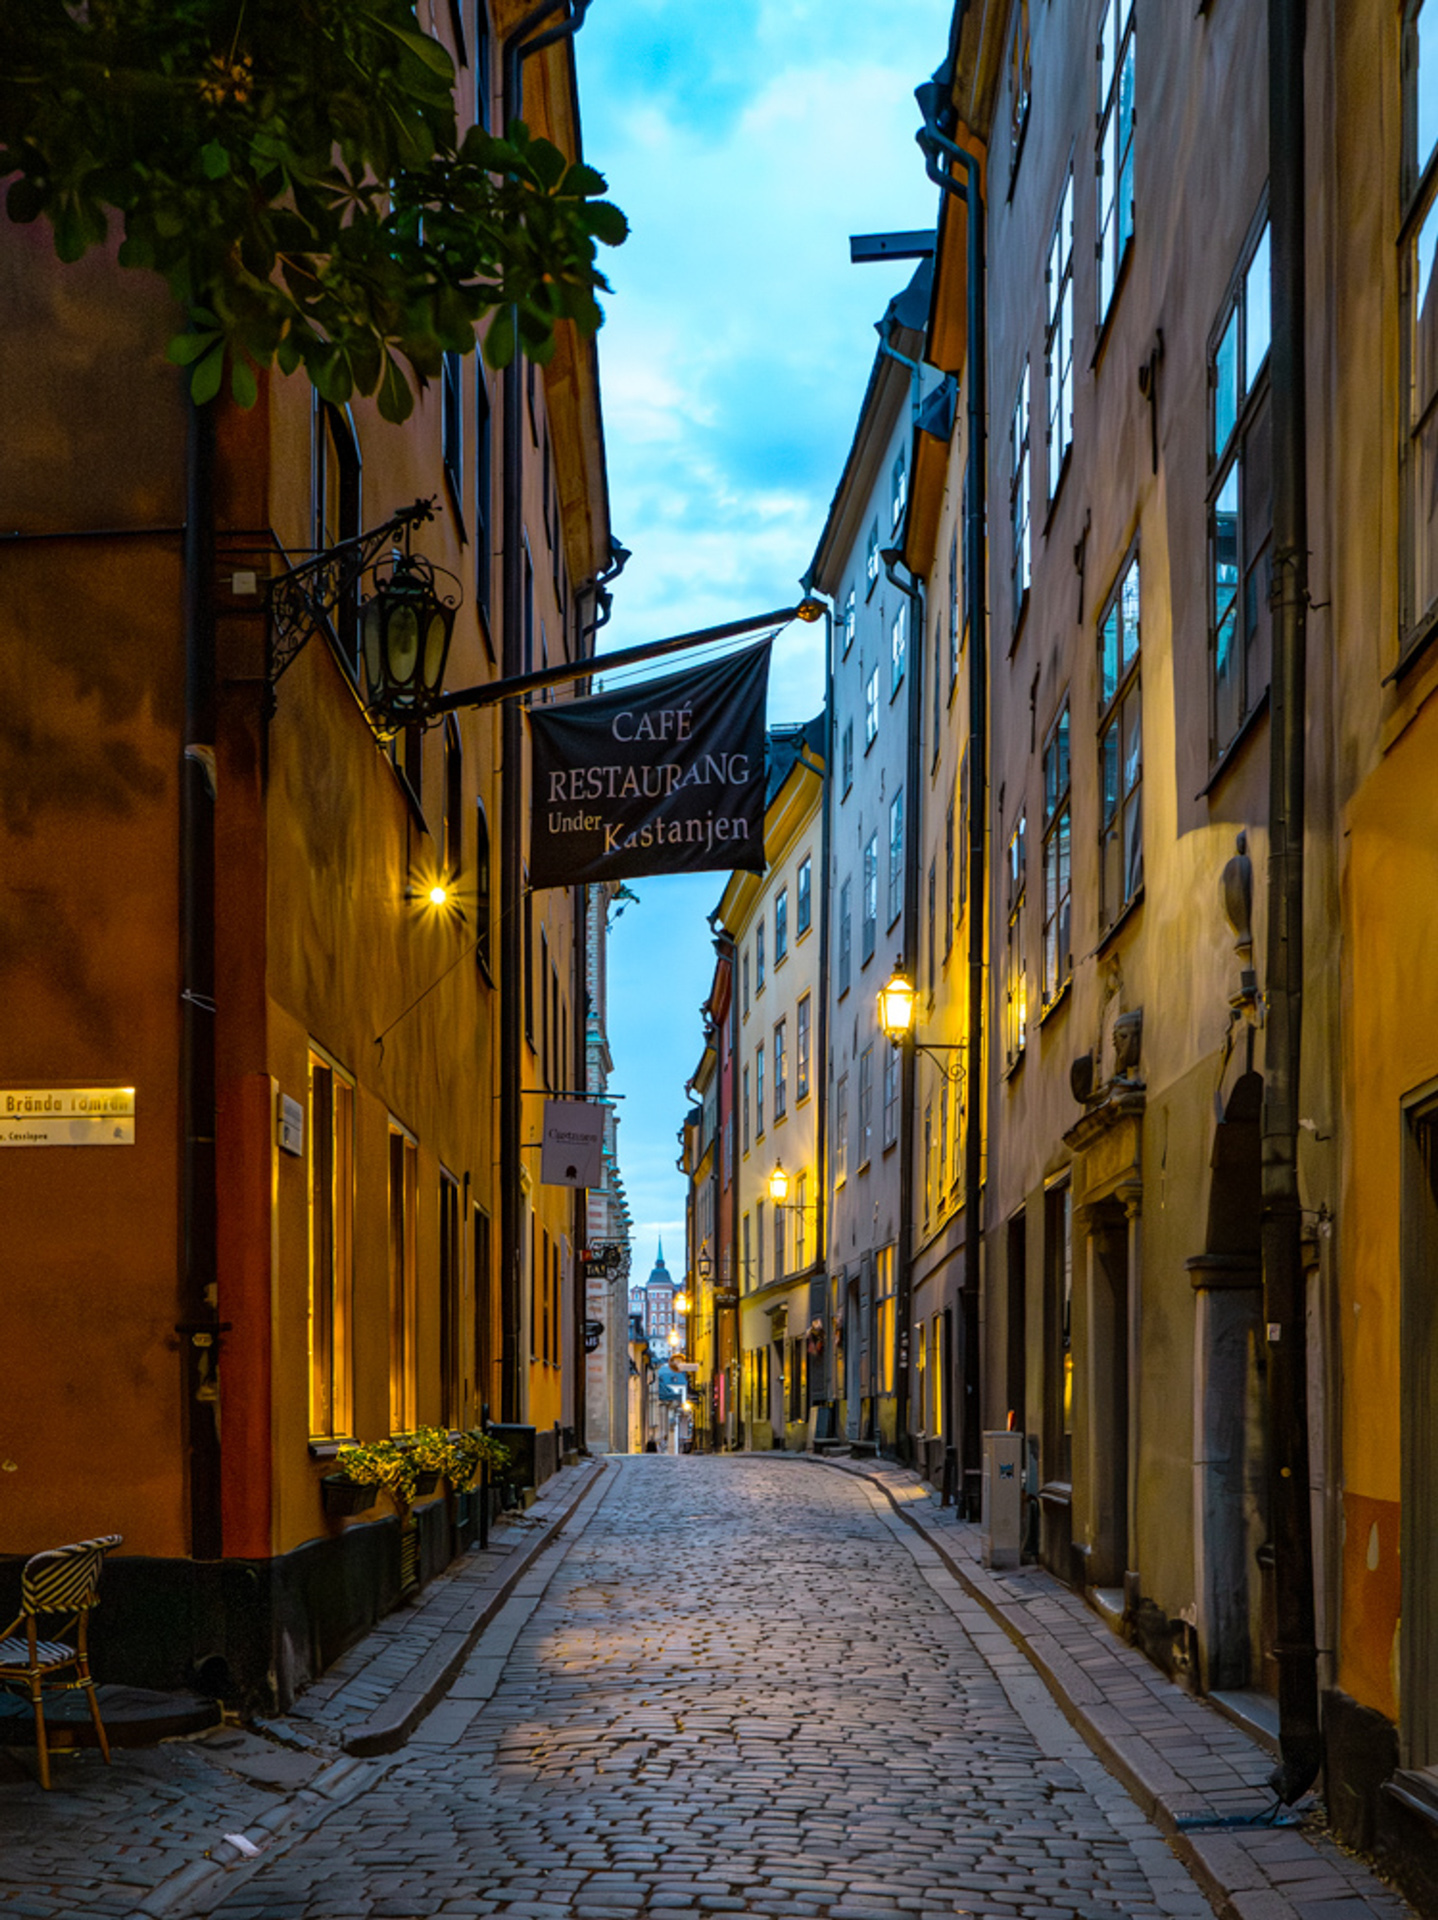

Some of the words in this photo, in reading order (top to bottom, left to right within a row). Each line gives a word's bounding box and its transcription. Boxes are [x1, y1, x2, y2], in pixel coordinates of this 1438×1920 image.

[611, 701, 693, 742] CAFÉ
[547, 752, 750, 802] RESTAURANG
[548, 810, 602, 834] Under
[603, 810, 750, 856] Kastanjen
[6, 1094, 63, 1112] Brända
